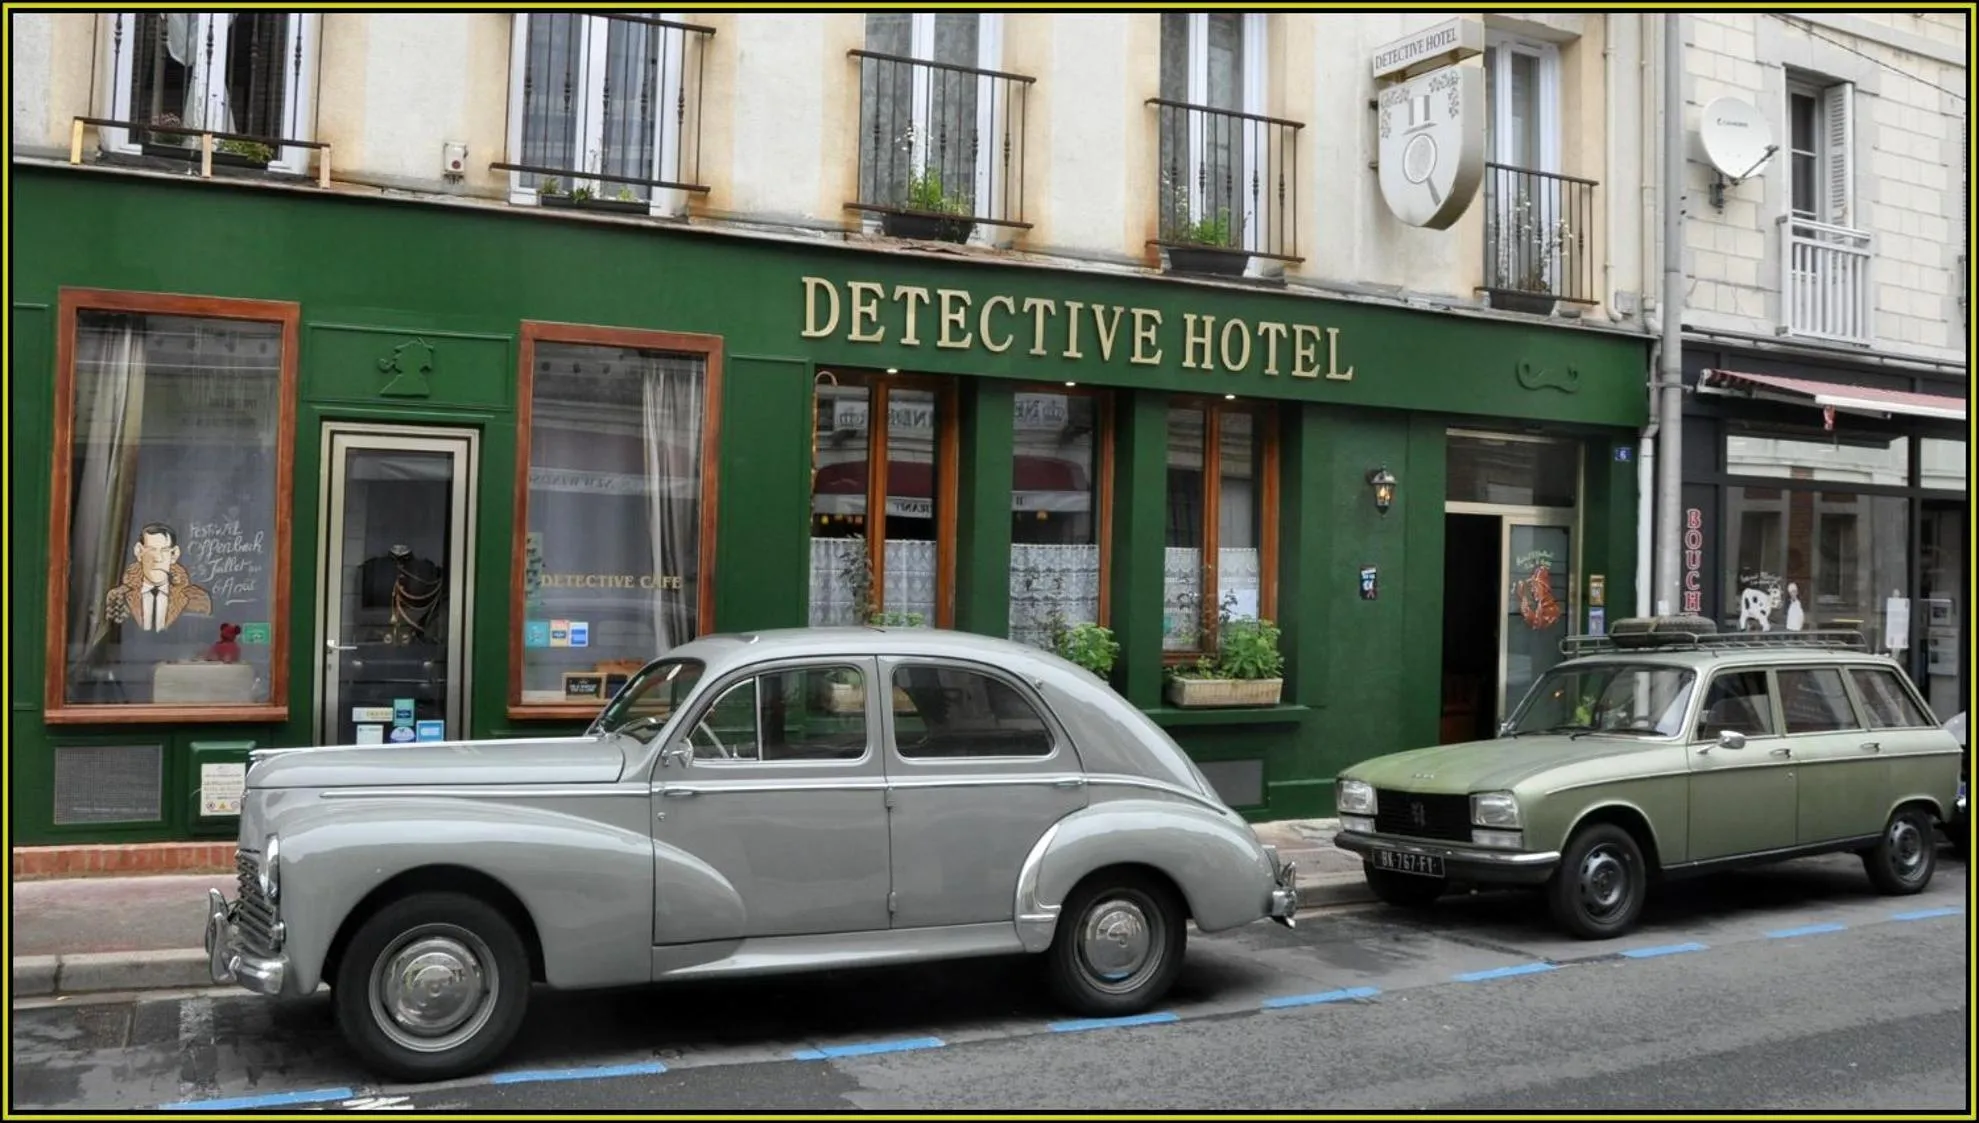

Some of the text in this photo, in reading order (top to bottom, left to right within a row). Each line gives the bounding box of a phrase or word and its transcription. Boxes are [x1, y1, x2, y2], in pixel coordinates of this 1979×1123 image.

[1375, 27, 1456, 70] DETECTIVE HOTEL
[800, 276, 1355, 381] DETECTIVE HOTEL
[541, 574, 634, 589] DETECTIVE
[1684, 508, 1703, 617] BOUCH
